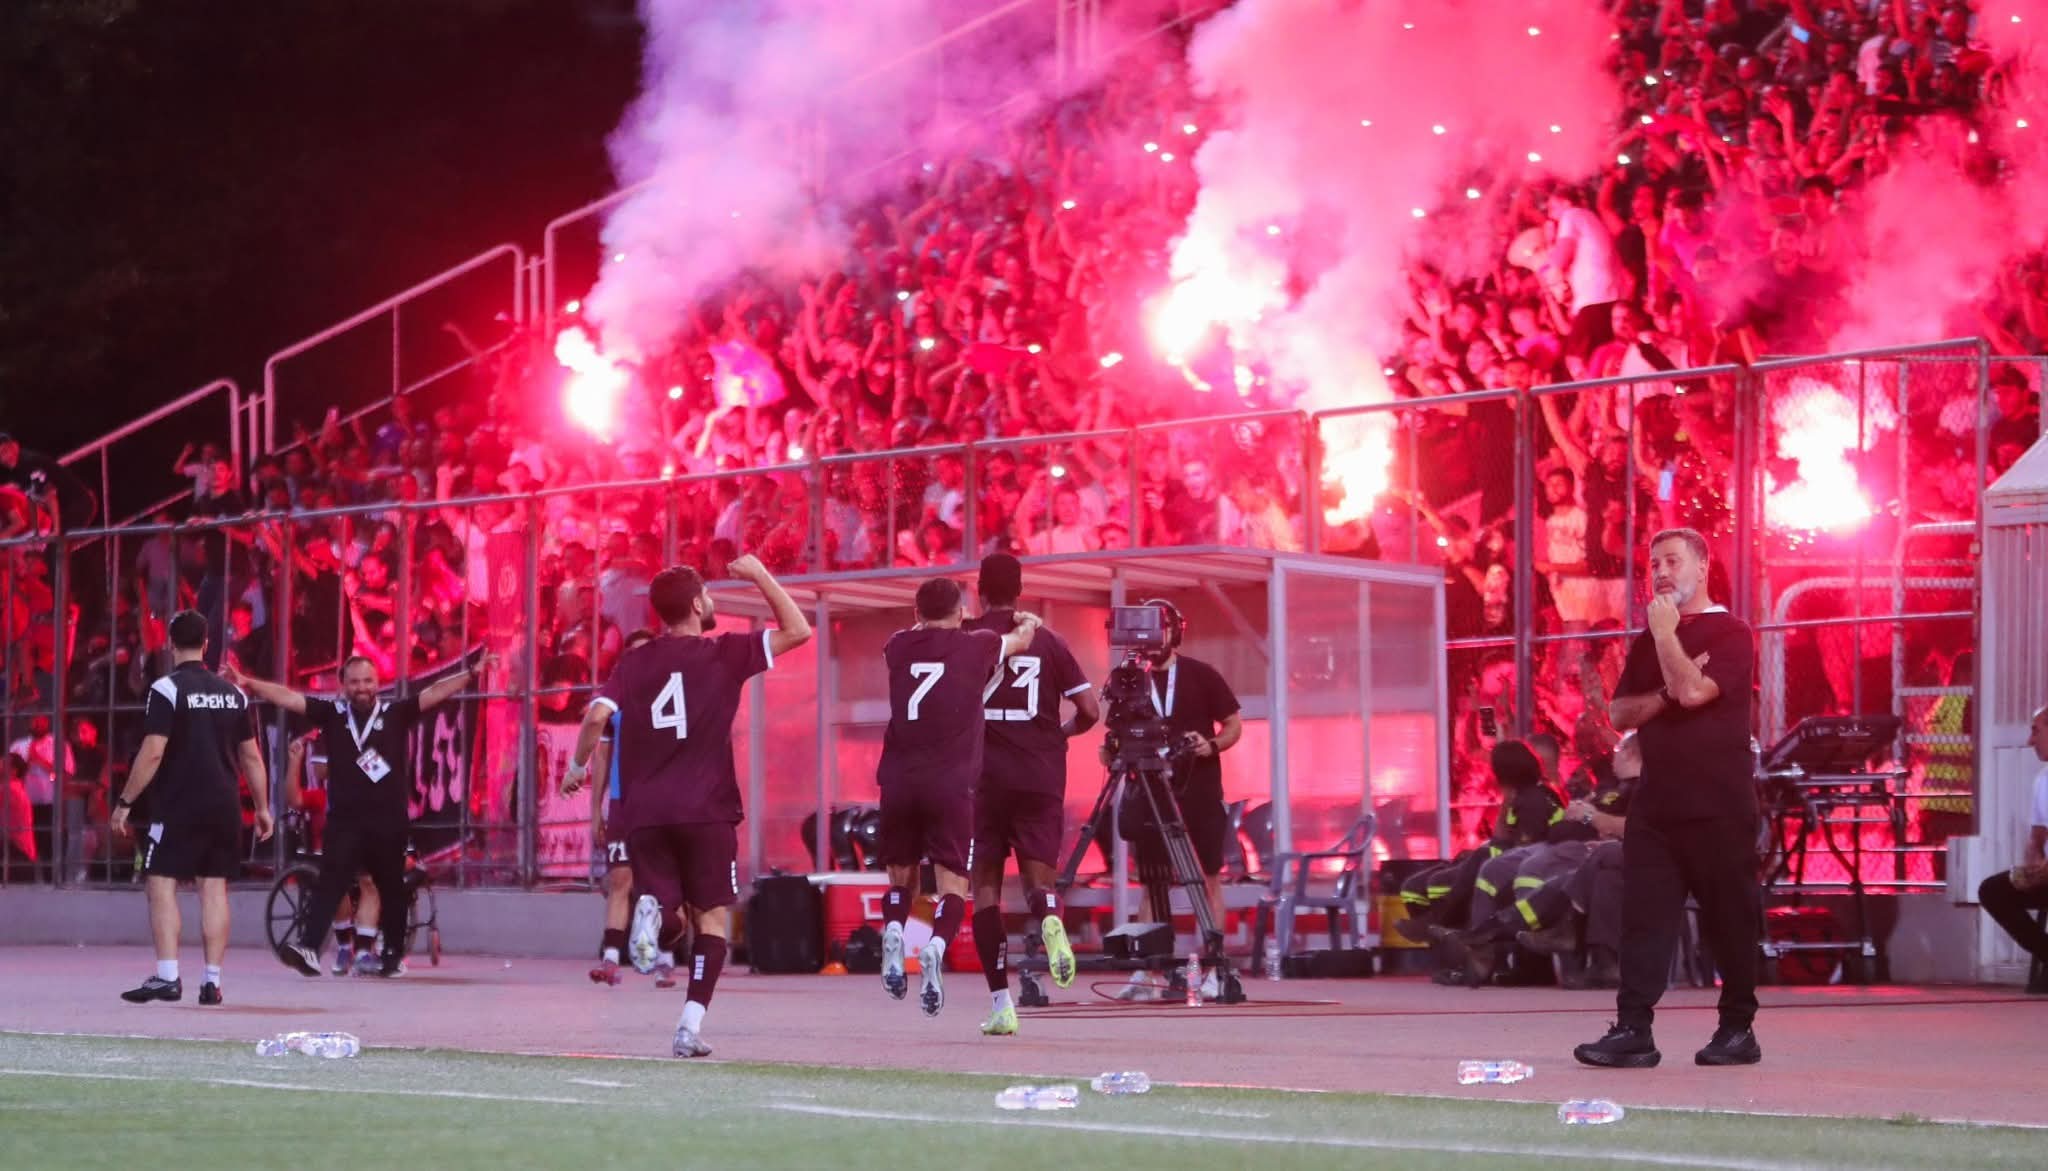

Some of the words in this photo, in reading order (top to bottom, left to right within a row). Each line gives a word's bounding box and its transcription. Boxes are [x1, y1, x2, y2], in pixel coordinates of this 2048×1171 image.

[225, 694, 239, 709] SL
[651, 671, 688, 740] 4
[907, 662, 945, 721] 7
[607, 841, 629, 863] 71
